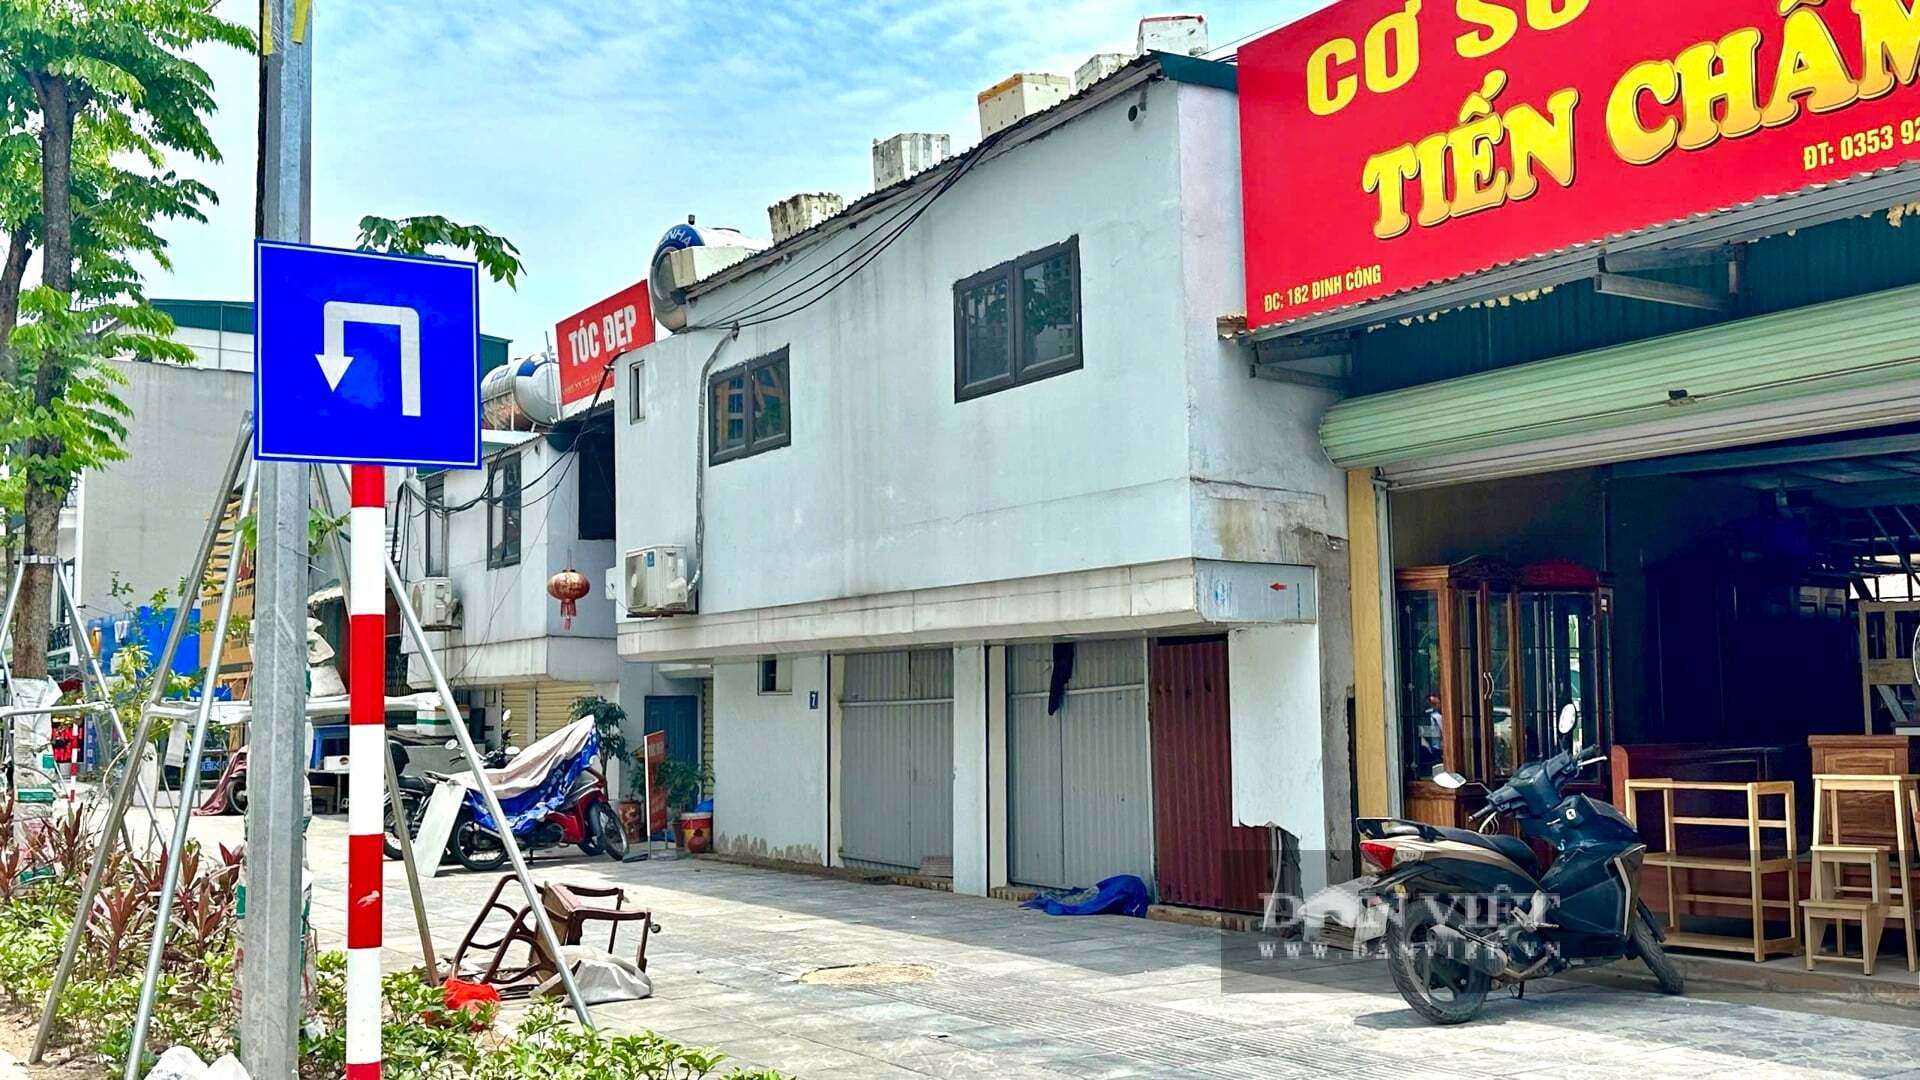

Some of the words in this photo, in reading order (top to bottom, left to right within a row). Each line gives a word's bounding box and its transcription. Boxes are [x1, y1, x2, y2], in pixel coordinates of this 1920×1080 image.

[1362, 69, 1581, 240] TIẾN
[1803, 141, 1835, 171] ĐT:
[1840, 124, 1894, 161] 0353
[1264, 292, 1284, 313] ĐC:
[1287, 284, 1309, 307] 182
[1311, 274, 1342, 303] ĐỊNH
[1345, 264, 1383, 291] CÔNG
[568, 319, 601, 367] TÓC
[602, 304, 637, 352] ĐẸP
